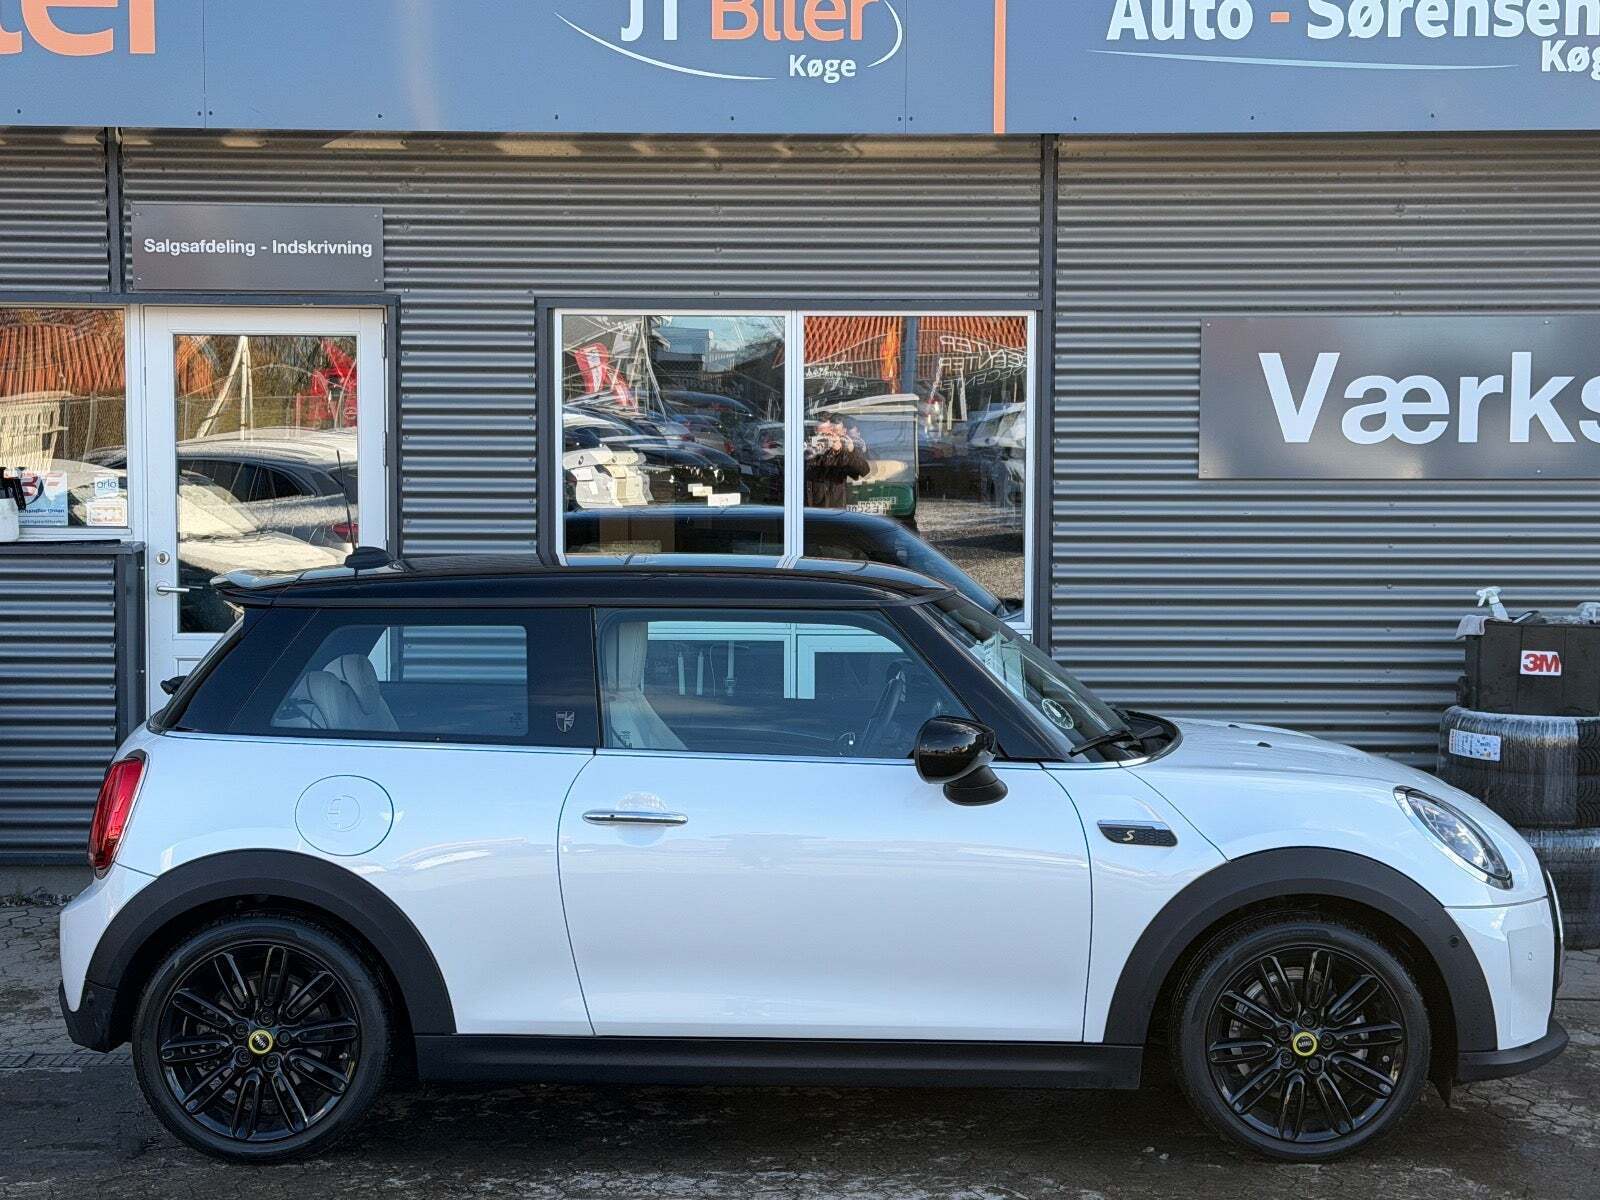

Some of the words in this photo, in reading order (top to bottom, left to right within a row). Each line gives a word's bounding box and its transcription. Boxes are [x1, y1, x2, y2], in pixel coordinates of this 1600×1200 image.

[1106, 0, 1253, 41] Auto
[1270, 11, 1290, 23] -
[1307, 0, 1600, 39] Sørensen
[789, 54, 857, 84] Køge
[143, 238, 256, 257] Salgsafdeling
[271, 239, 373, 258] Indskrivning
[1522, 653, 1561, 673] 3M
[1122, 829, 1136, 842] S
